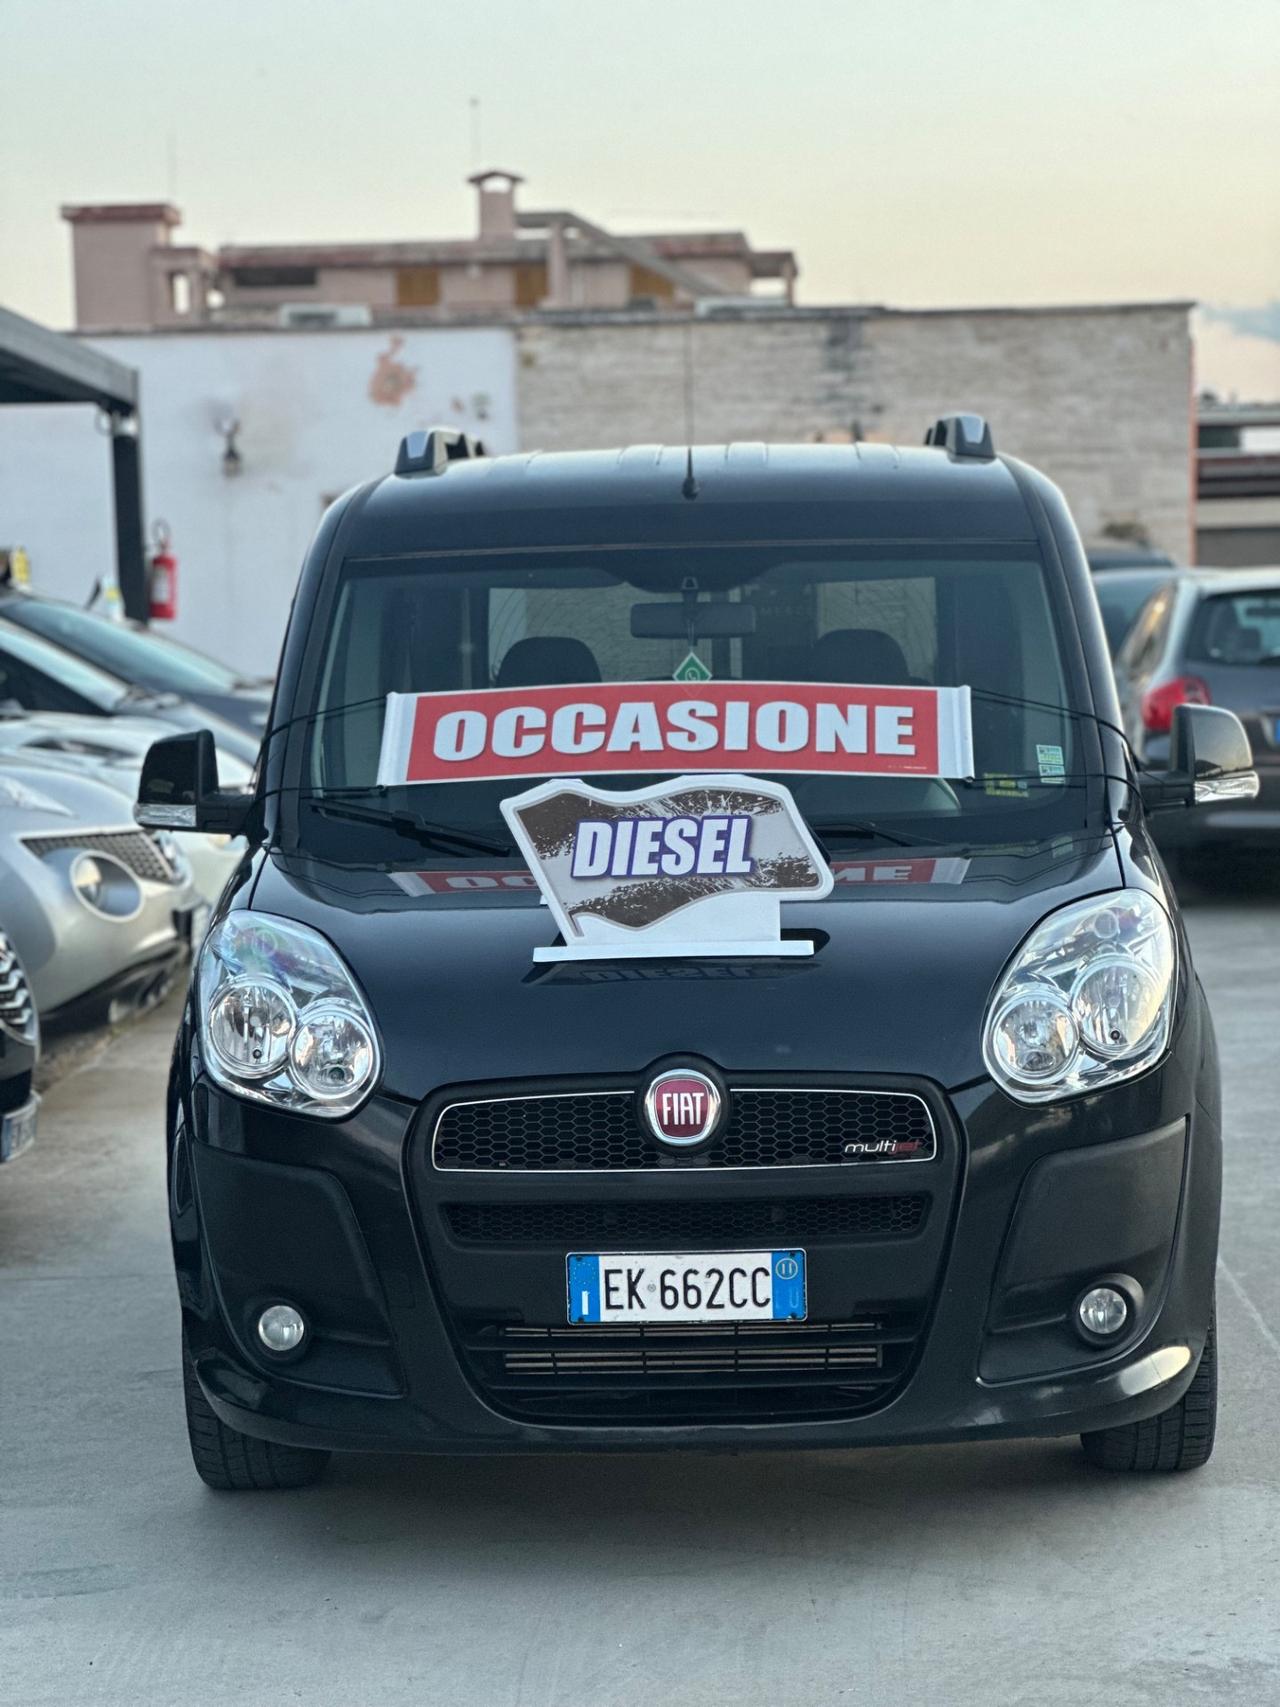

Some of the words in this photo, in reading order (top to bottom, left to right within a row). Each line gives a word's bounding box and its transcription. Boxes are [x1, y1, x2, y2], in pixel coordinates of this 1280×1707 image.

[433, 700, 916, 761] OCCASIONE
[572, 818, 752, 877] DIESEL
[662, 1092, 705, 1126] FIAT
[582, 1290, 589, 1316] I
